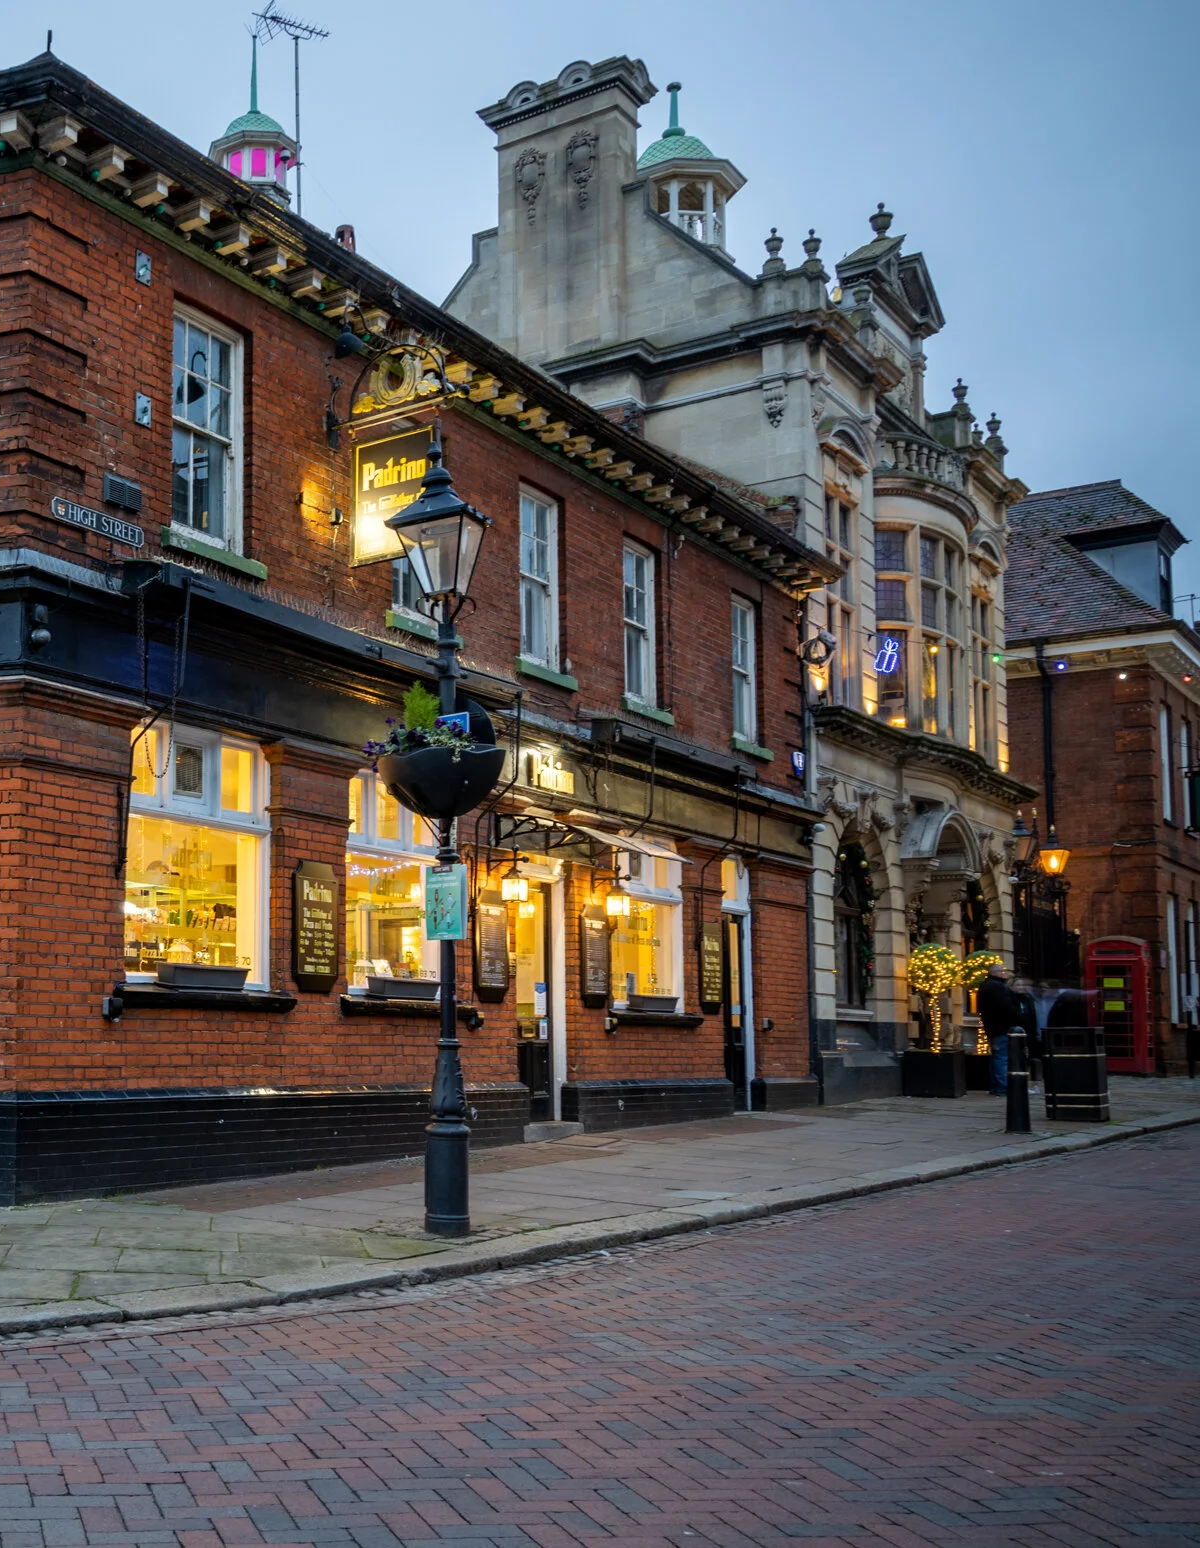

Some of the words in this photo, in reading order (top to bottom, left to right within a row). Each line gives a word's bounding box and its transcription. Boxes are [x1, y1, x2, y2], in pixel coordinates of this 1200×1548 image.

[362, 457, 426, 492] Padrino
[68, 504, 97, 528] HIGH
[101, 516, 140, 543] STREET
[362, 500, 377, 514] The
[532, 749, 575, 795] Padrino
[303, 879, 332, 903] Padrino
